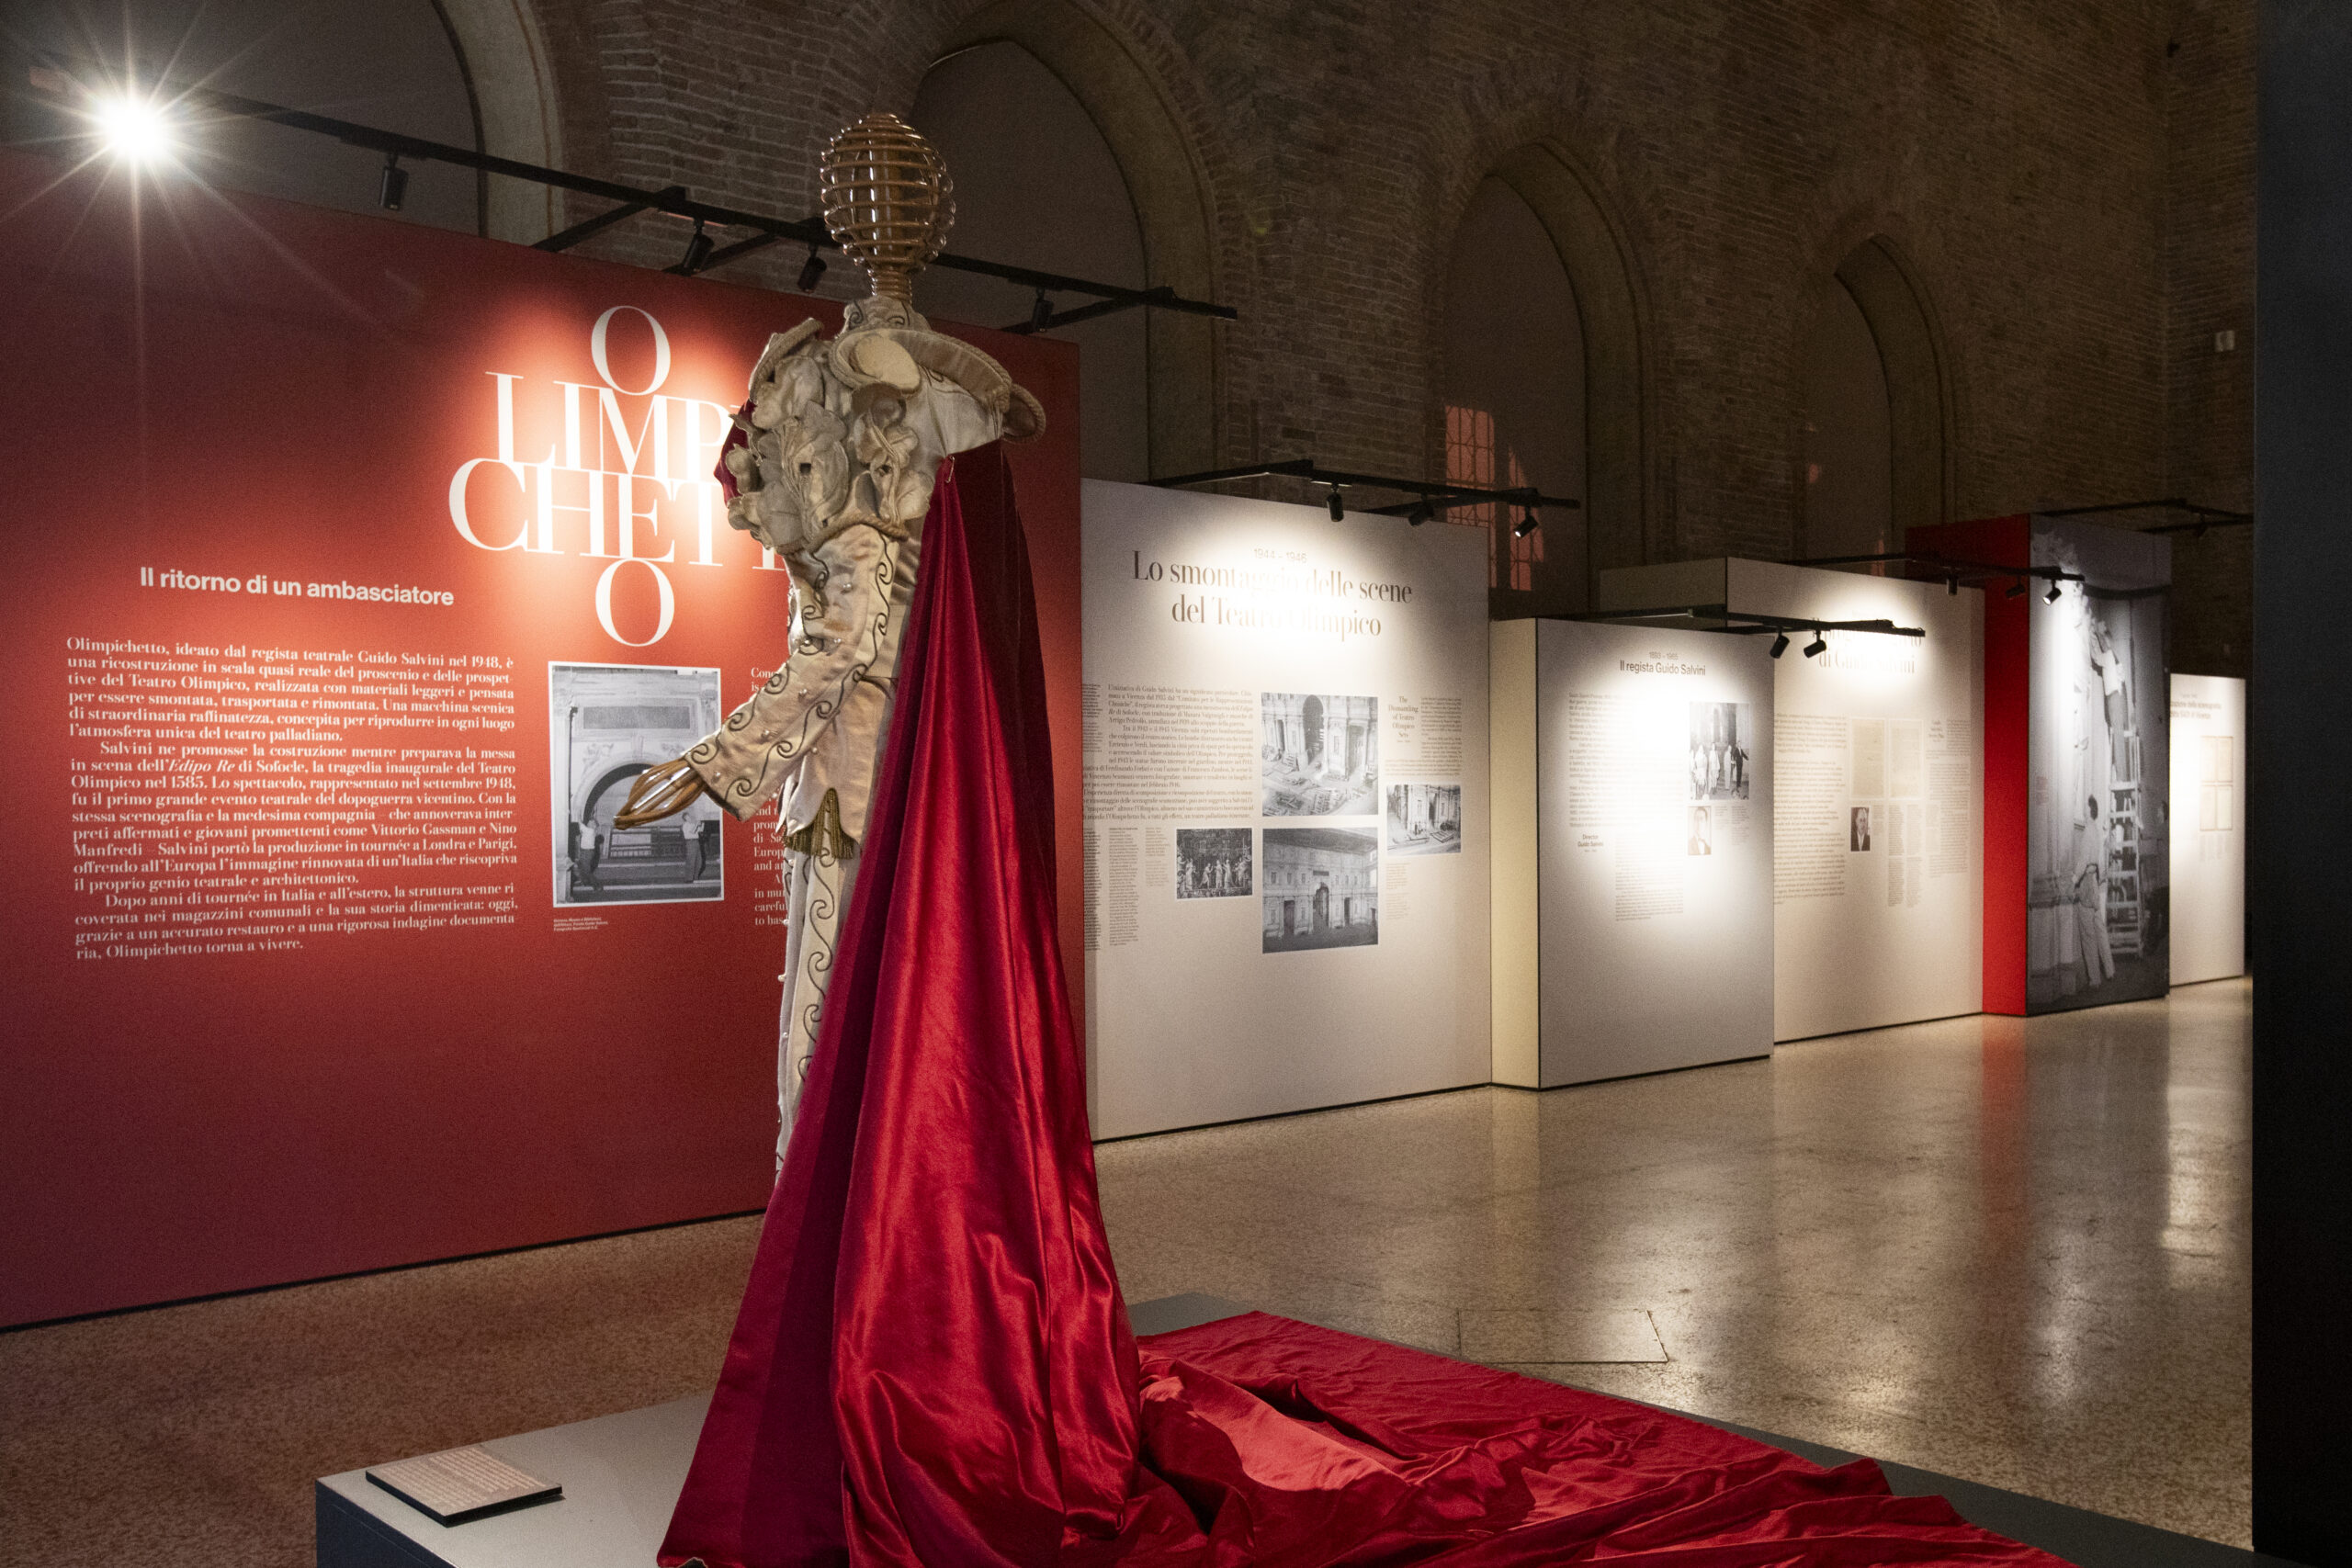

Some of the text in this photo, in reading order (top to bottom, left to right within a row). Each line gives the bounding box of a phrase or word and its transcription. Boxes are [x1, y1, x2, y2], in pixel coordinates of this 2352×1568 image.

[591, 305, 671, 396] O
[485, 371, 744, 484] LIMP
[449, 457, 785, 571] CHET
[141, 567, 455, 605] Il ritorno di un ambasciatore
[1132, 550, 1163, 581] Lo
[1306, 569, 1353, 599] delle
[1359, 579, 1412, 604] scene
[595, 558, 674, 647] O
[1171, 594, 1205, 624] del
[175, 642, 220, 657] ideato
[223, 644, 246, 658] dal
[251, 647, 299, 662] regista
[303, 649, 353, 662] teatrale
[356, 650, 397, 664] Guido
[401, 652, 445, 666] Salvini
[448, 655, 467, 667] nel
[1620, 660, 1706, 676] Il regista Guido Salvini
[67, 671, 96, 685] tive
[100, 672, 123, 686] del
[131, 673, 176, 688] Teatro
[254, 679, 319, 693] realizzata
[322, 683, 347, 694] con
[351, 682, 408, 695] materiali
[412, 683, 454, 700] leggeri
[469, 689, 514, 701] pensata
[68, 692, 95, 705] per
[97, 693, 144, 704] essere
[221, 694, 298, 710] trasportata
[382, 698, 408, 711] Una
[411, 700, 469, 712] macchina
[471, 702, 514, 714] scenica
[68, 706, 85, 719] di
[87, 707, 186, 721] straordinaria
[277, 712, 340, 728] concepita
[343, 716, 366, 728] per
[368, 714, 435, 729] riprodurre
[436, 715, 449, 727] in
[451, 716, 480, 731] ogni
[481, 716, 514, 732] luogo
[155, 726, 196, 739] unica
[198, 726, 220, 739] del
[224, 728, 266, 739] teatro
[100, 741, 515, 761] Salvini ne promosse la costruzione mentre preparava la messa
[70, 758, 86, 771] in
[90, 761, 132, 772] scena
[216, 759, 235, 772] Re
[238, 760, 252, 772] di
[312, 760, 324, 773] la
[327, 761, 382, 776] tragedia
[386, 761, 453, 776] inaugurale
[456, 761, 474, 773] del
[480, 761, 516, 773] Teatro
[70, 775, 141, 793] Olimpico
[144, 775, 166, 788] nel
[211, 775, 230, 788] Lo
[310, 778, 399, 793] rappresentato
[401, 777, 420, 789] nel
[423, 777, 482, 789] settembre
[754, 860, 772, 871] and
[74, 877, 85, 891] il
[88, 876, 145, 895] proprio
[149, 875, 190, 893] genio
[193, 874, 247, 887] teatrale
[74, 912, 138, 925] coverata
[143, 909, 165, 923] nei
[171, 907, 243, 925] magazzini
[248, 905, 311, 919] comunali
[328, 905, 340, 917] la
[344, 907, 366, 916] sua
[369, 902, 405, 915] storia
[106, 942, 202, 961] Olimpichetto
[206, 942, 243, 953] torna
